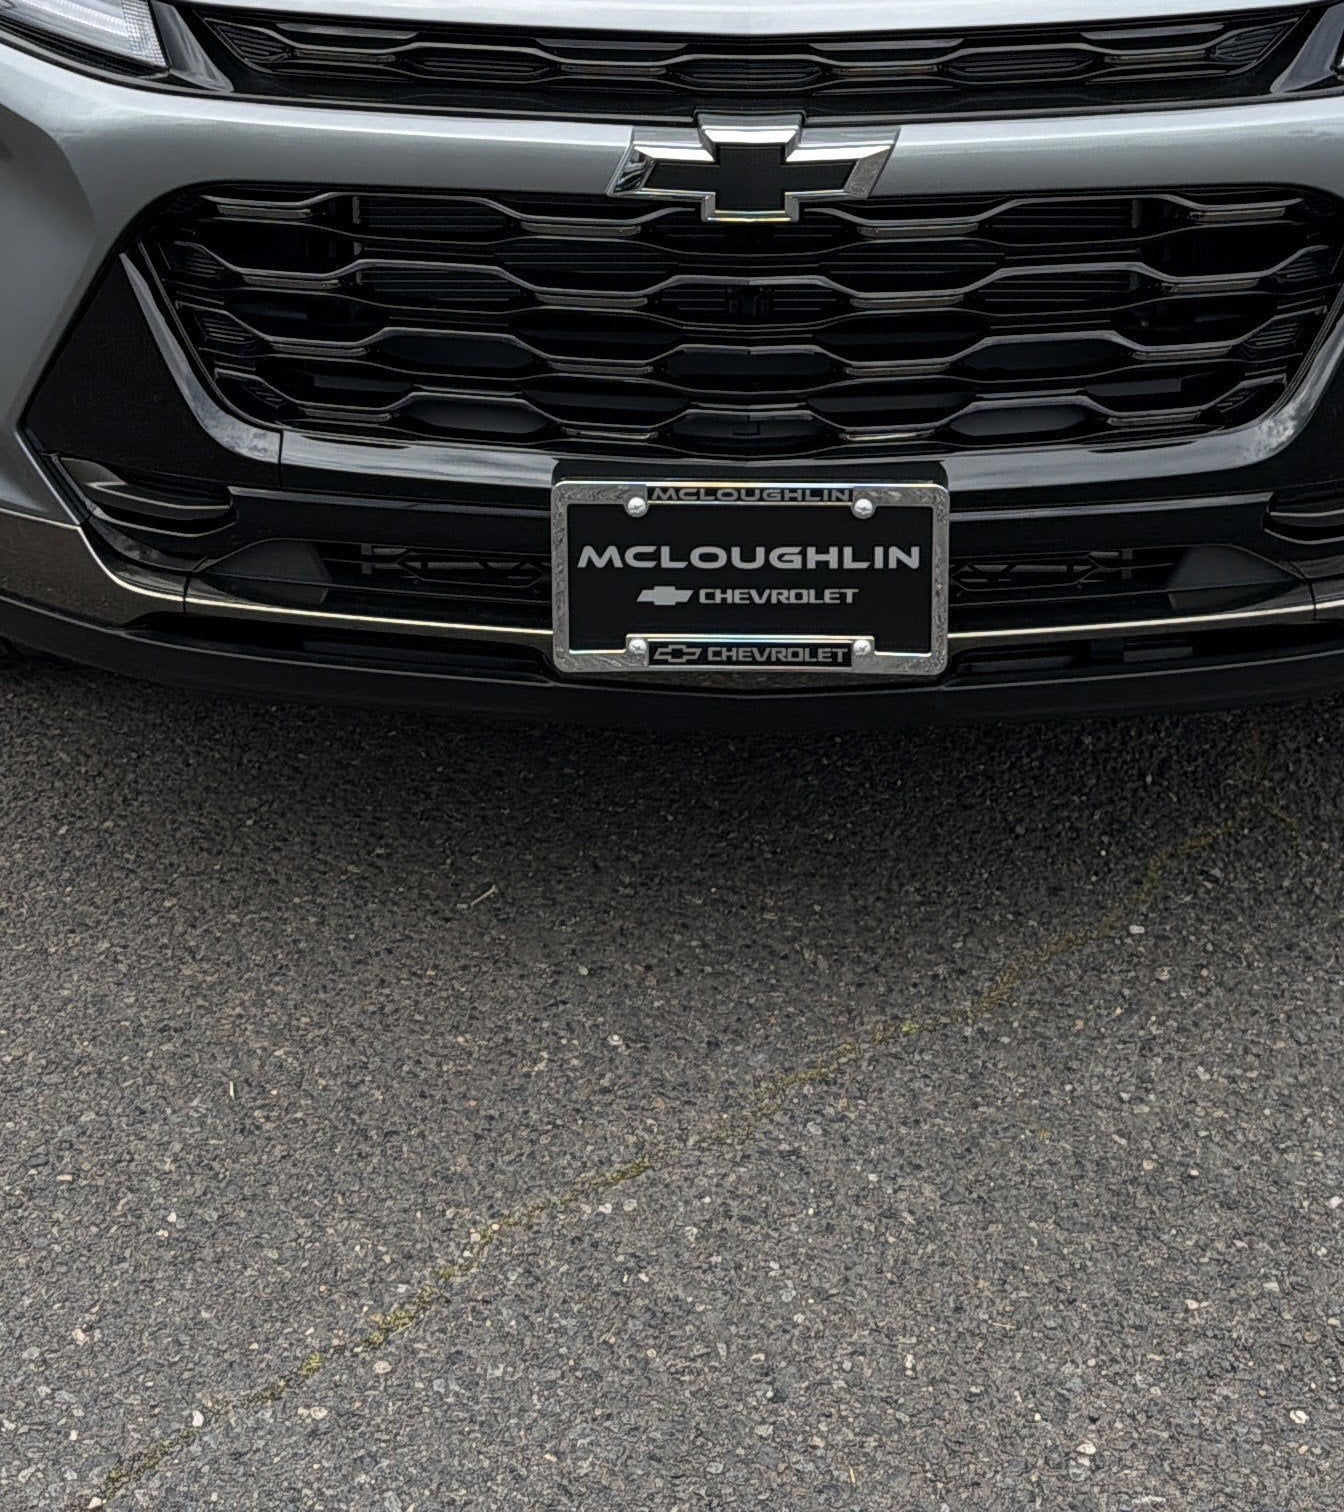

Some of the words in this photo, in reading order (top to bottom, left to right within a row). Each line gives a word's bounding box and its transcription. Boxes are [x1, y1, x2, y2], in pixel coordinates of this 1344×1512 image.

[653, 487, 851, 502] MCLOUGHLIN
[577, 545, 920, 570] MCLOUGHLIN
[699, 588, 860, 605] CHEVROLET
[707, 647, 849, 663] CHEVROLET
